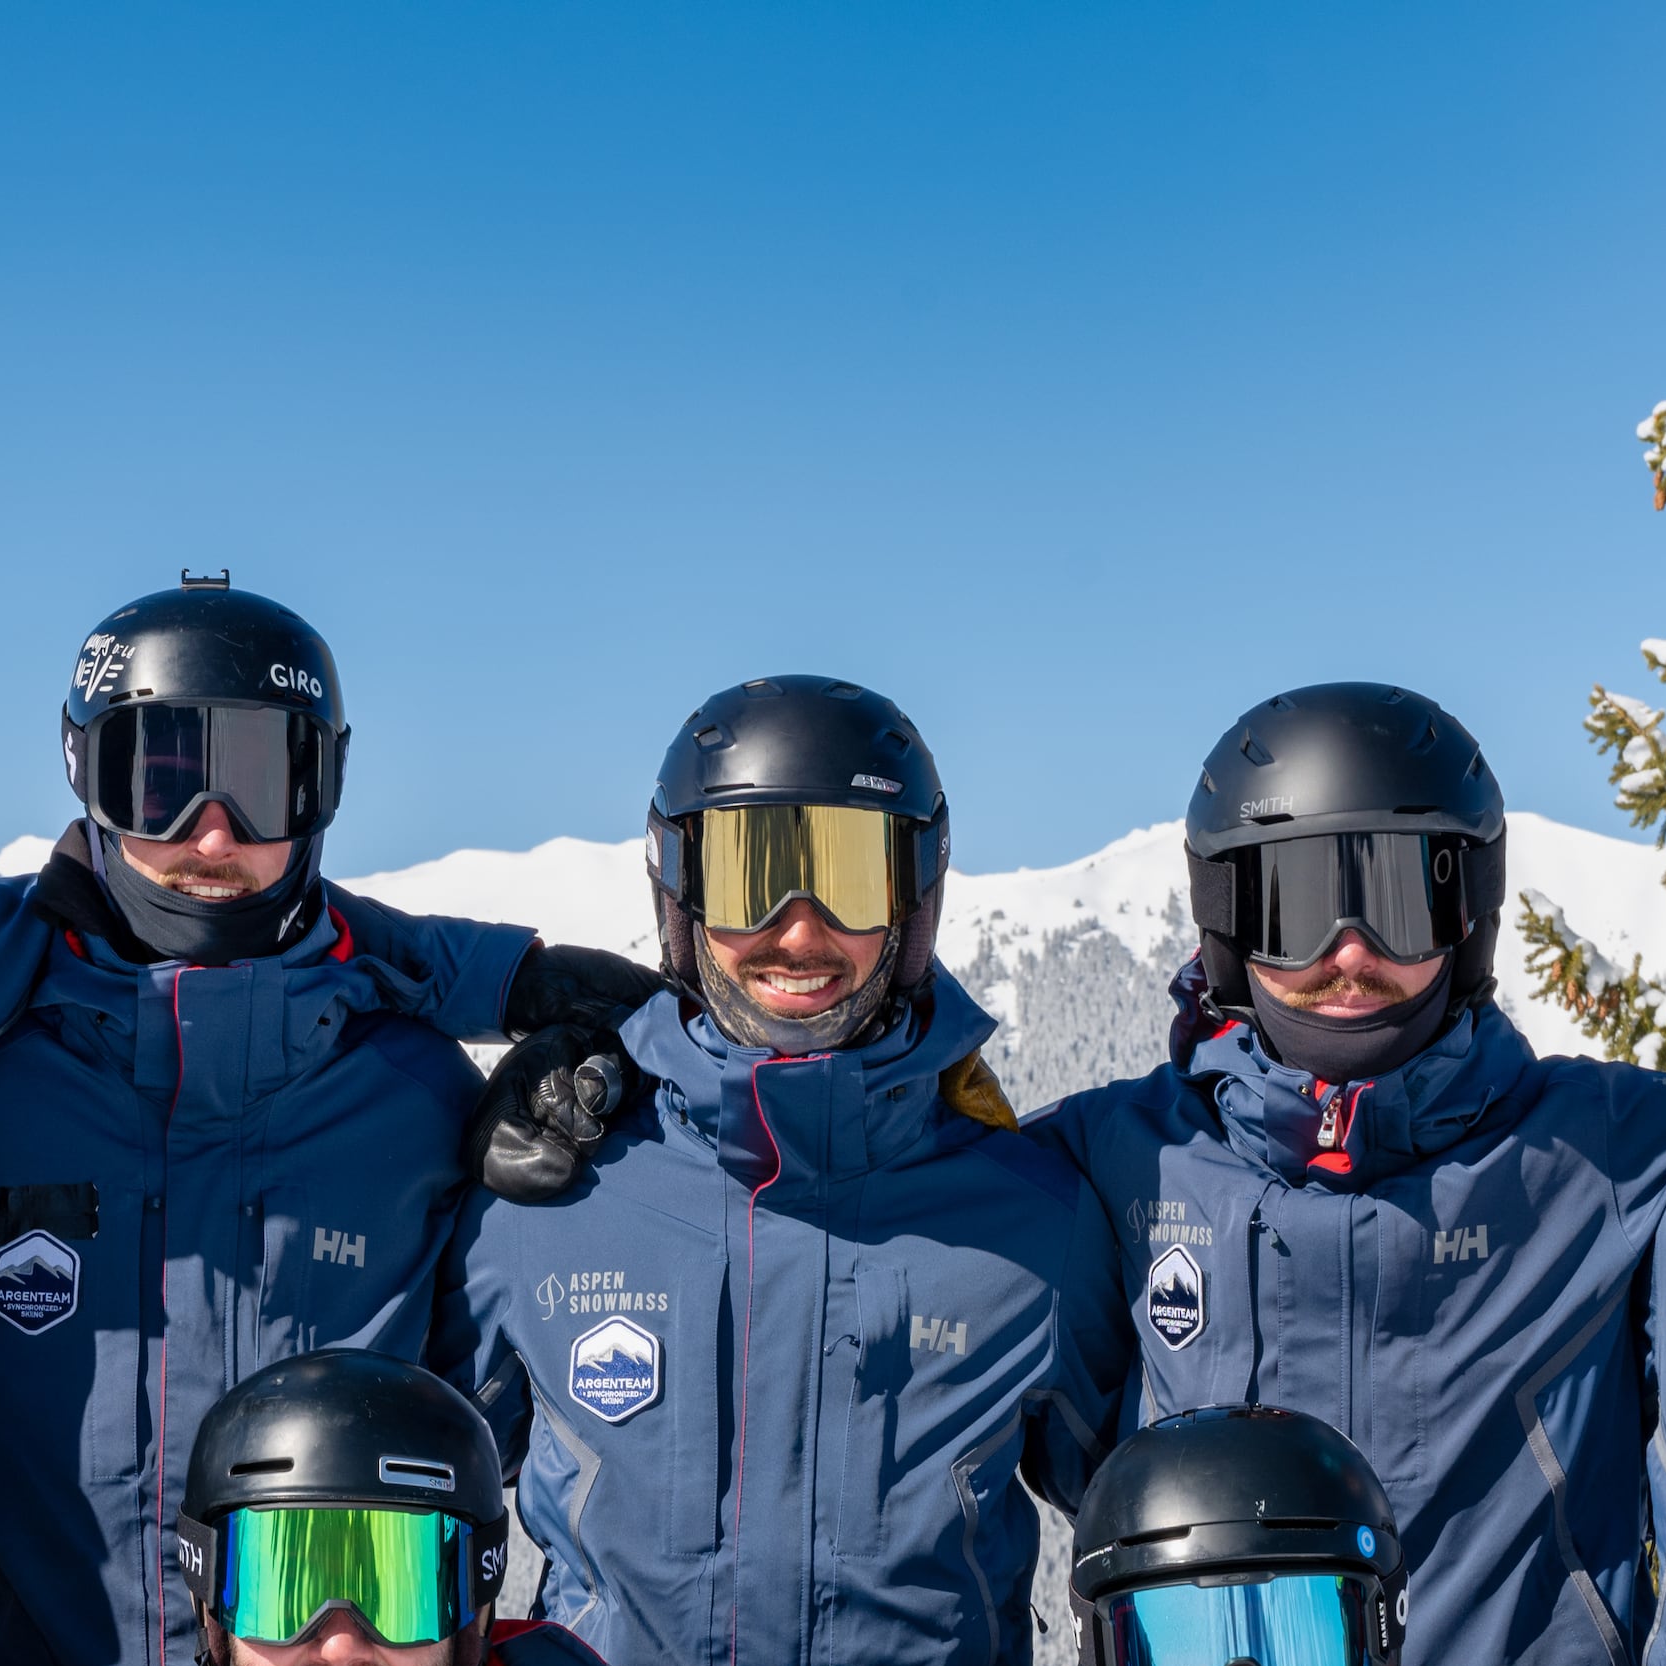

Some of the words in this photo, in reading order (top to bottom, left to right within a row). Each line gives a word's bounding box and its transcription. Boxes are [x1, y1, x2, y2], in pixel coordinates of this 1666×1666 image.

[270, 663, 323, 699] GIRO
[1239, 796, 1294, 818] SMITH
[1148, 1200, 1186, 1221] ASPEN
[1148, 1223, 1213, 1246] SNOWMASS
[1433, 1224, 1489, 1264] HH
[313, 1226, 366, 1268] HH
[569, 1271, 625, 1292] ASPEN
[7, 1303, 59, 1312] SYNCHRONIZED
[569, 1292, 668, 1314] SNOWMASS
[1152, 1304, 1198, 1321] ARGENTEAM
[910, 1315, 967, 1355] HH
[576, 1377, 651, 1389] ARGENTEAM
[587, 1390, 639, 1398] SYNCHRONIZED
[1379, 1602, 1388, 1648] OAKLEY
